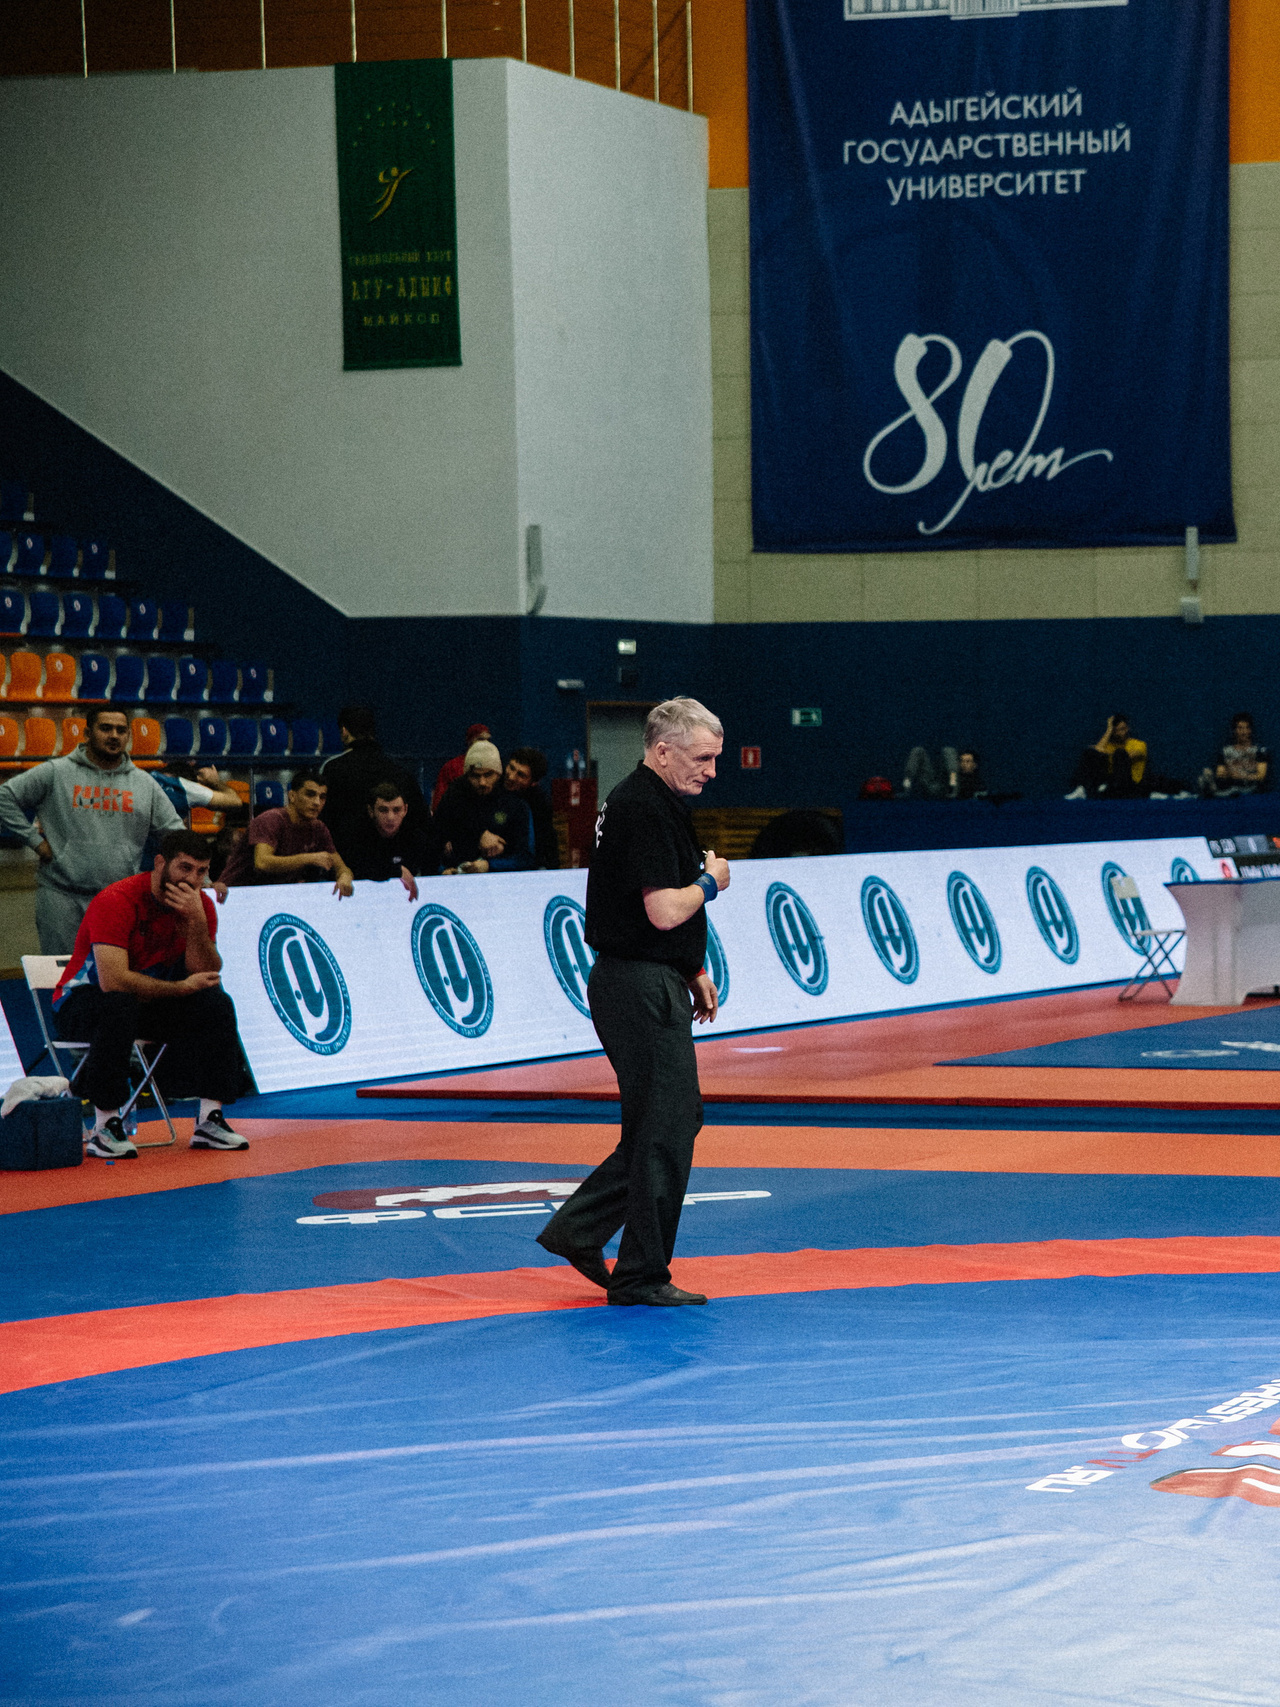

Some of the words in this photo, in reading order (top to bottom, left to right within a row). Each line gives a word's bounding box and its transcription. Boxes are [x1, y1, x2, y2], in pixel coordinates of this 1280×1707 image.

[890, 87, 1082, 127] АДЫГЕЙСКИЙ
[844, 123, 1130, 166] ГОСУДАРСТВЕННЫЙ
[887, 169, 1086, 205] УНИВЕРСИТЕТ
